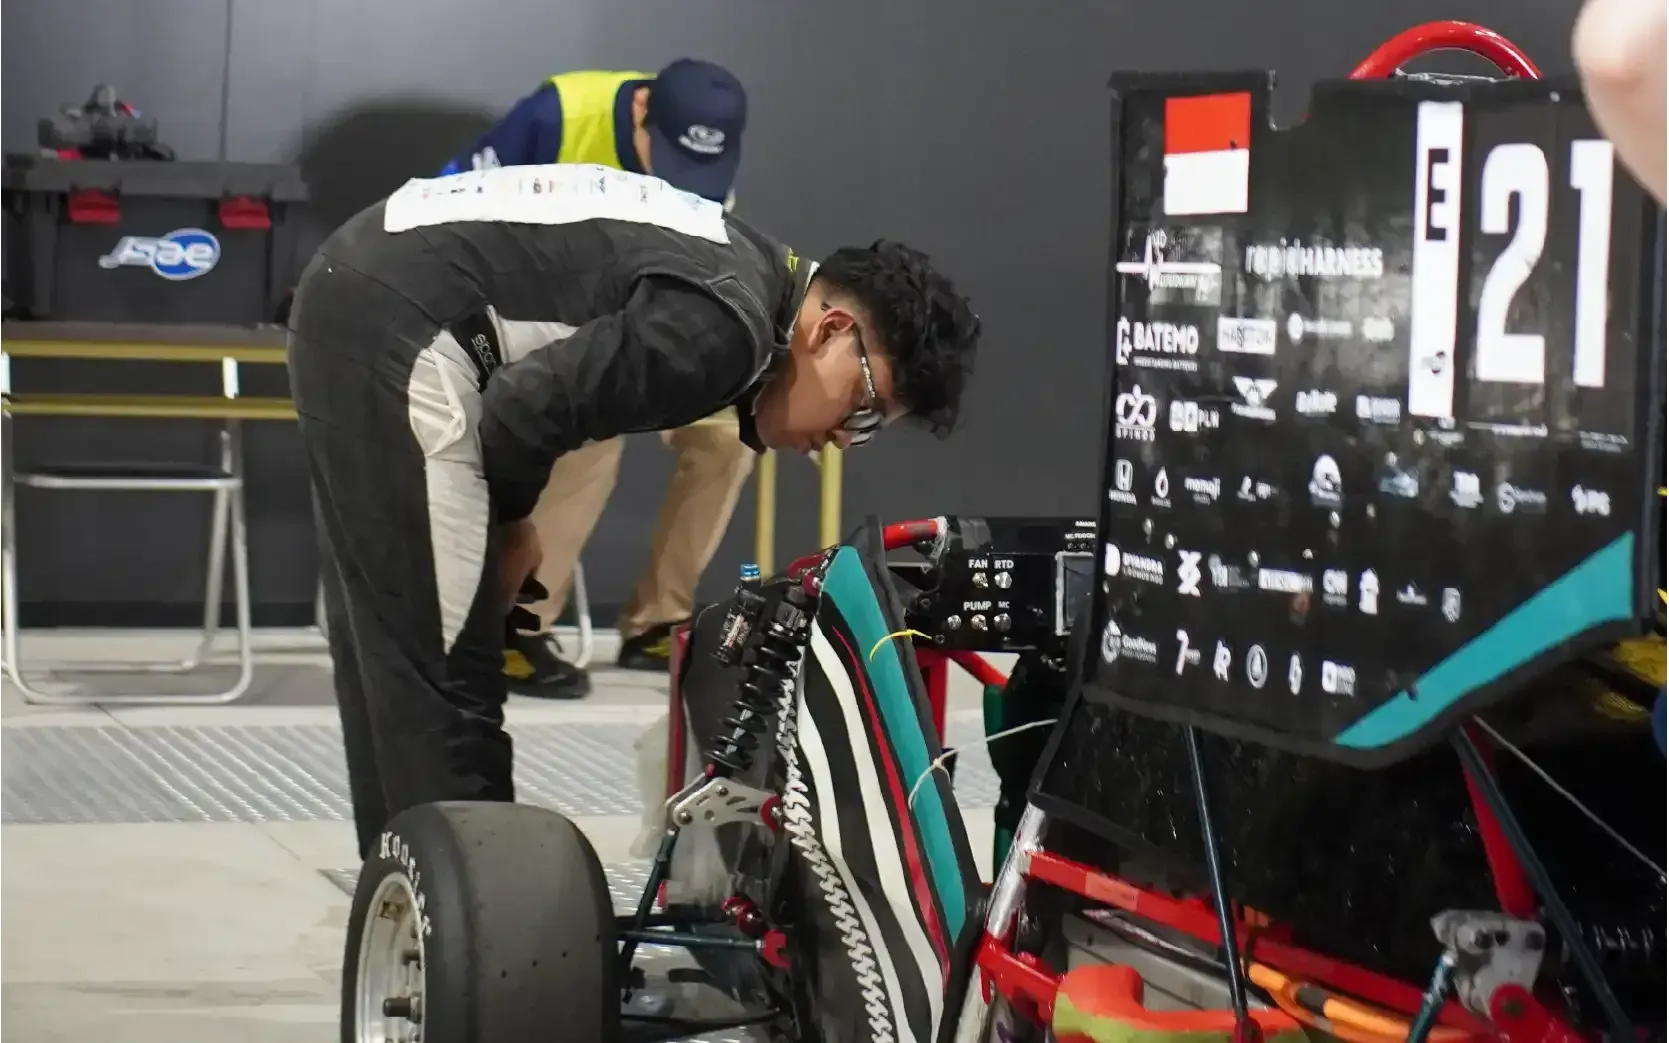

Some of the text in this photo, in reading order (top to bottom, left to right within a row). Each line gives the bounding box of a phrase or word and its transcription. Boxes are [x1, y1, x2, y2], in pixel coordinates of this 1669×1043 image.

[1425, 148, 1449, 241] E
[1477, 140, 1614, 387] 21
[1133, 321, 1199, 355] BATEMO
[968, 559, 1014, 569] FAN RTD
[963, 601, 1010, 611] PUMP MC
